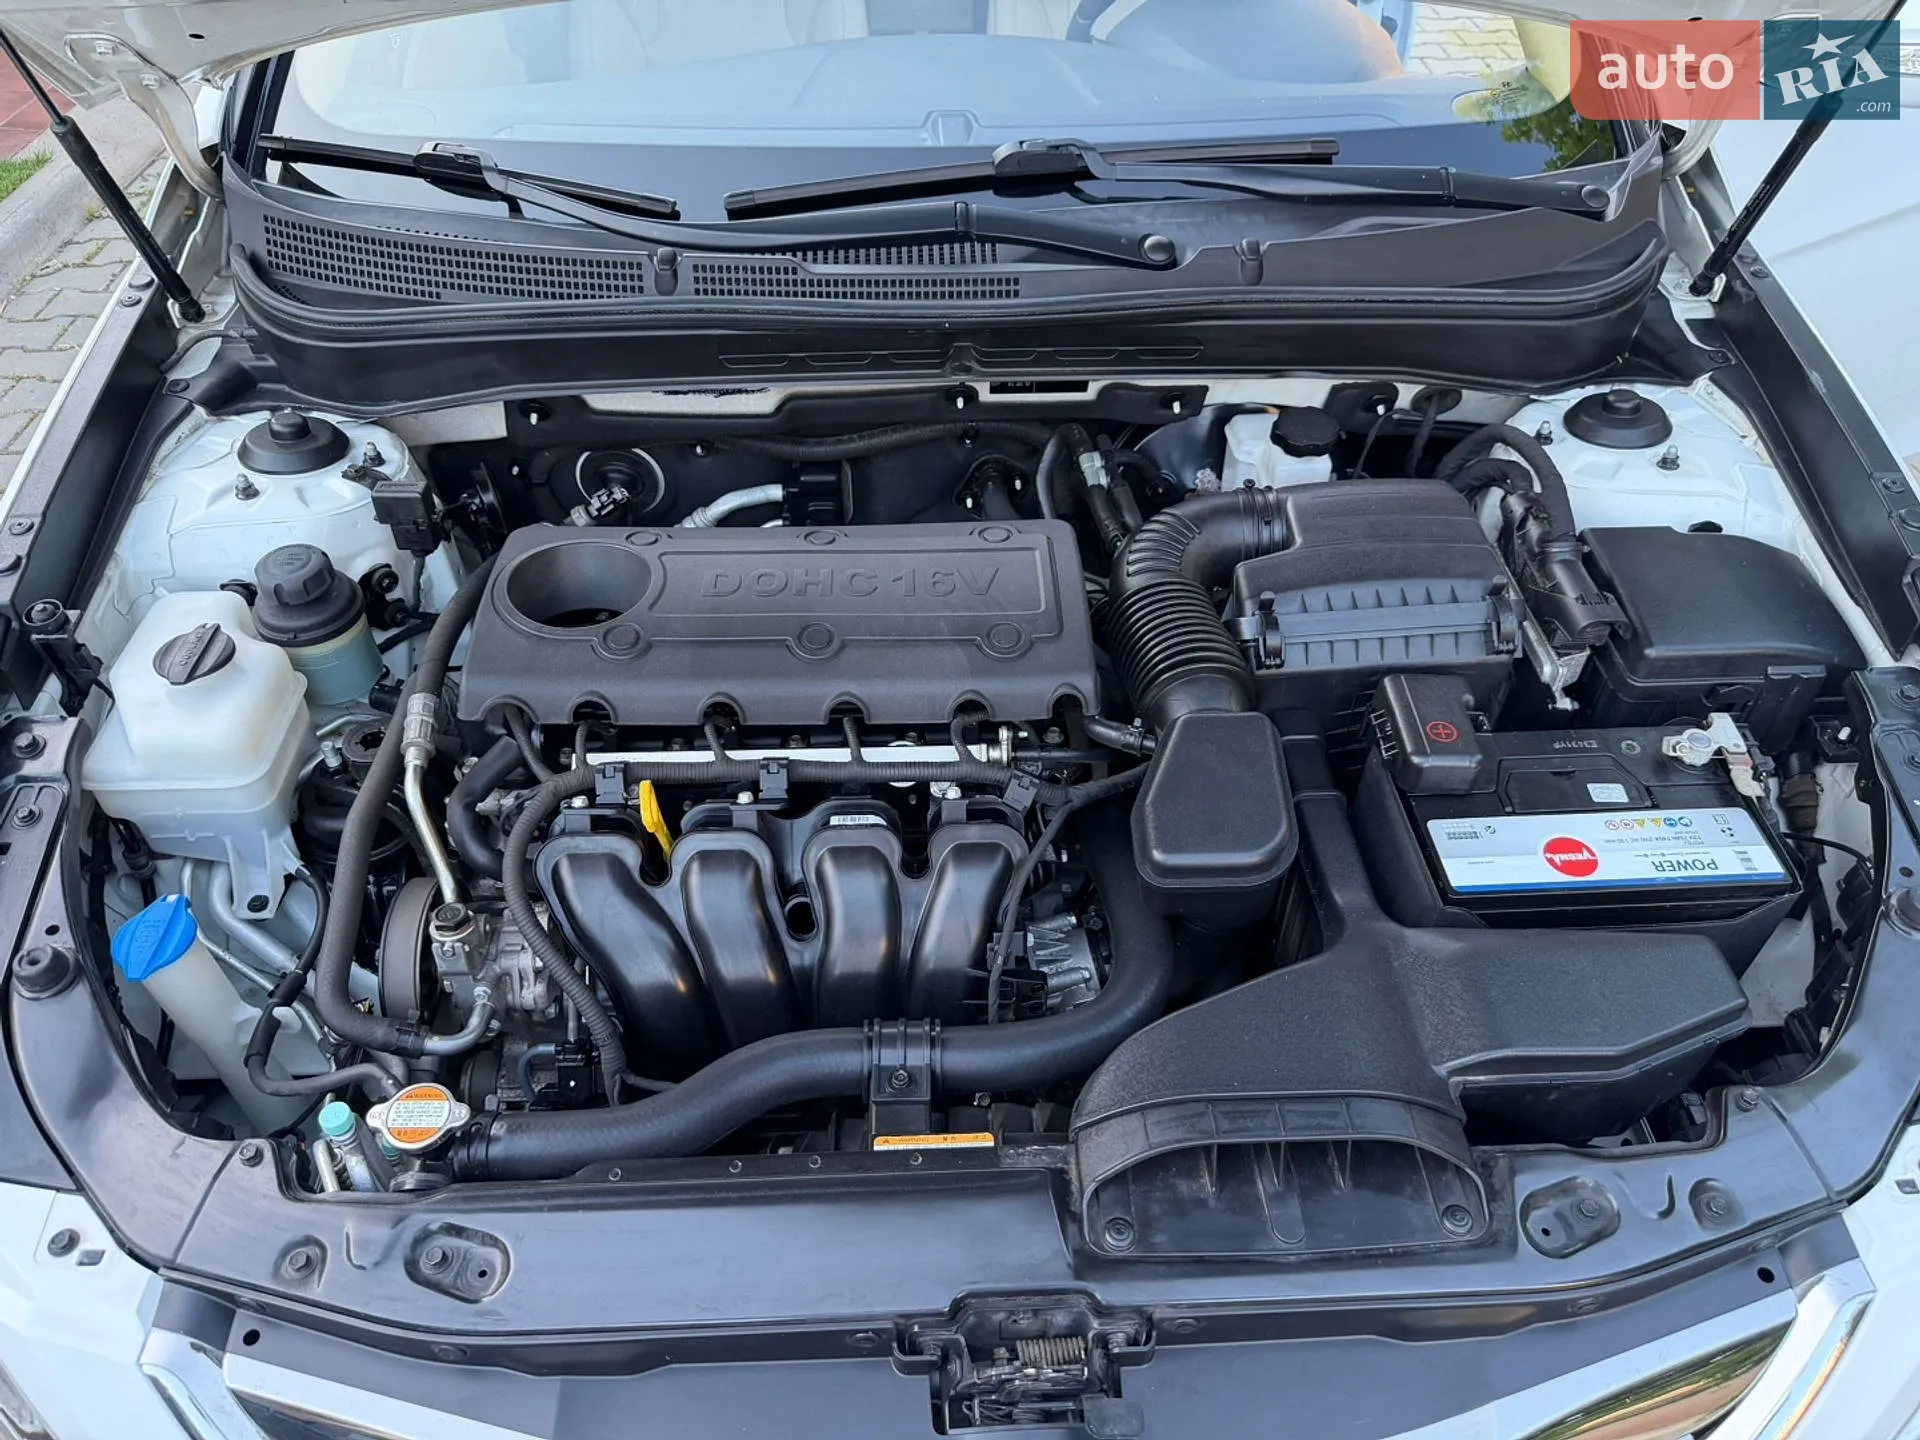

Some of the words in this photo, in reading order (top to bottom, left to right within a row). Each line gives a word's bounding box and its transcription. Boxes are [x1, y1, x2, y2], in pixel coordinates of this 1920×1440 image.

[700, 567, 879, 598] DOHC
[891, 566, 1000, 598] 16V
[1651, 858, 1719, 873] POWER
